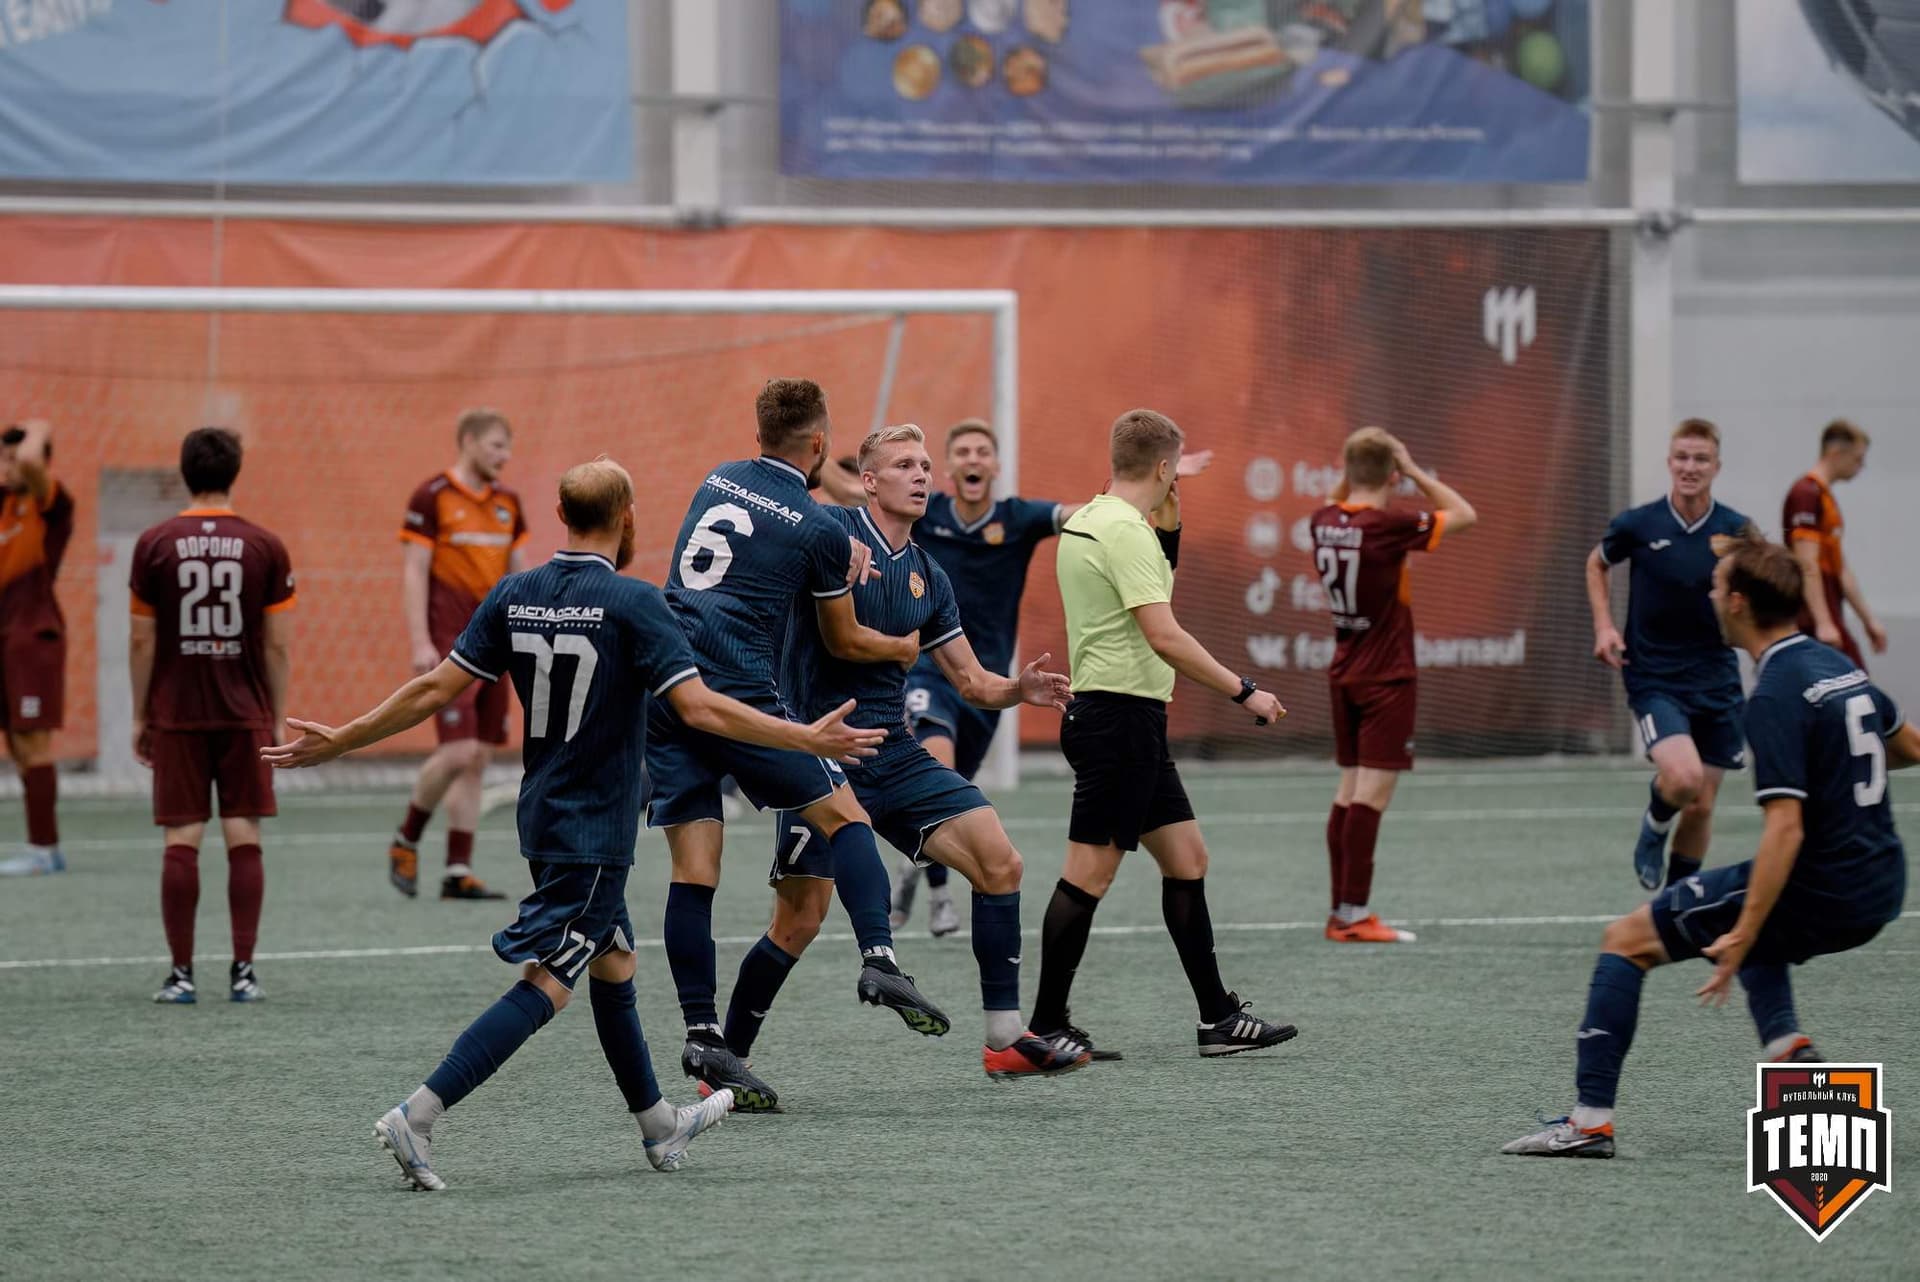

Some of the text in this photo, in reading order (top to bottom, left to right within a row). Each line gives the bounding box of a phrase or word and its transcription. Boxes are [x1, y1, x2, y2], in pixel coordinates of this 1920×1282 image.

[176, 536, 244, 560] ВОРОНА
[679, 502, 754, 591] 6
[1316, 546, 1361, 615] 27
[177, 560, 243, 638] 23
[511, 631, 599, 743] 77
[1845, 693, 1887, 807] 5
[788, 825, 812, 865] 7
[550, 930, 596, 979] 77
